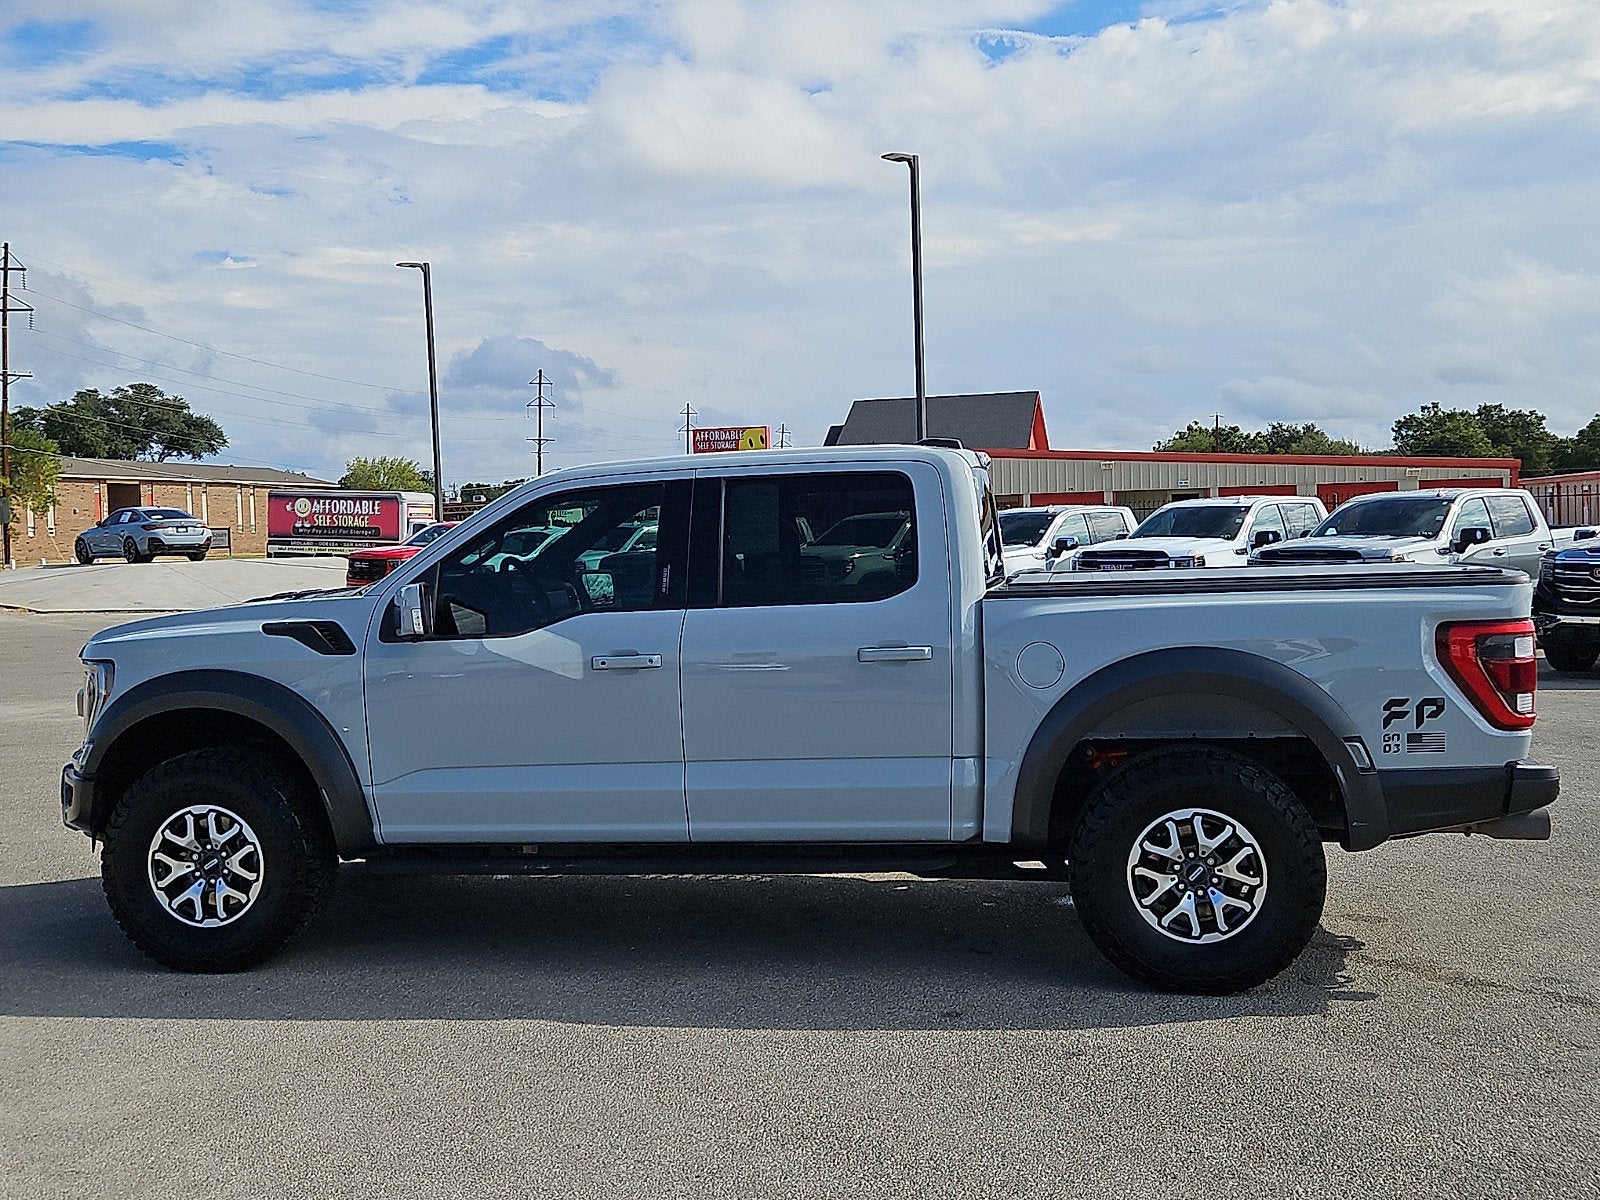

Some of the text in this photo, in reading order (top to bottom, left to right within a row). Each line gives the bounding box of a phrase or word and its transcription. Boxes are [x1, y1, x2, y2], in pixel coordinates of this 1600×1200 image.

[695, 430, 744, 441] AFFORDABLE
[697, 440, 736, 450] SELF STORAGE
[312, 499, 381, 514] AFFORDABLE
[313, 514, 369, 527] SELF STORAGE
